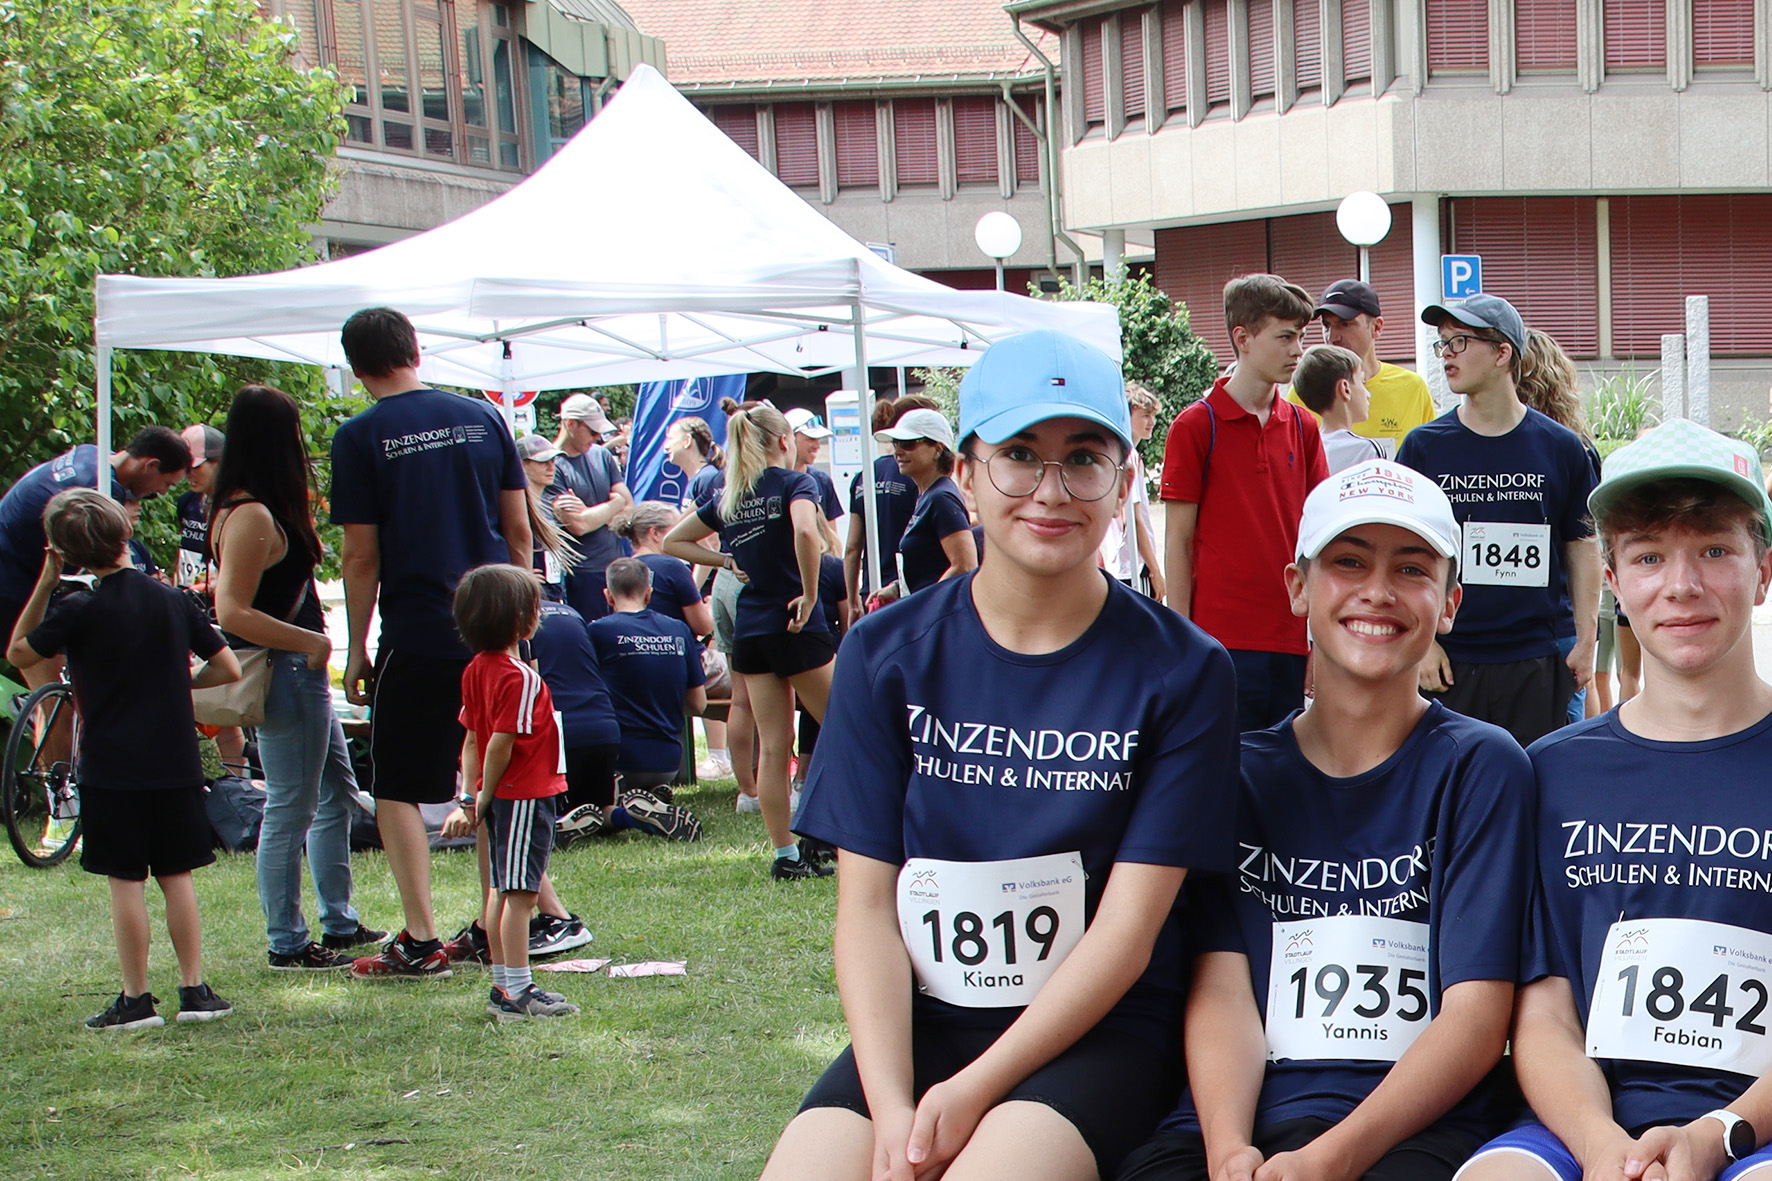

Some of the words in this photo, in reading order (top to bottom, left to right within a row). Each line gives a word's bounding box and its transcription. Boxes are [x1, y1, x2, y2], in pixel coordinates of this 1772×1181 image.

[1451, 260, 1472, 294] P
[382, 428, 451, 452] ZINZENDORF
[386, 447, 416, 460] SCHULEN
[423, 439, 454, 451] INTERNAT
[1438, 474, 1545, 490] ZINZENDORF
[1339, 488, 1368, 498] NEW
[1379, 487, 1414, 501] YORK
[1487, 493, 1494, 502] &
[1497, 491, 1543, 502] INTERNAT
[1472, 543, 1541, 569] 1848
[1495, 569, 1517, 579] Fynn
[617, 635, 673, 645] ZINZENDORF
[635, 643, 676, 652] SCHULEN
[906, 704, 1140, 762] ZINZENDORF
[1000, 767, 1018, 787] &
[1026, 766, 1133, 791] INTERNAT
[1018, 878, 1060, 890] Volksbank
[1062, 876, 1072, 884] eG
[1565, 863, 1657, 888] SCHULEN
[1663, 865, 1681, 885] &
[1240, 875, 1329, 917] SCHULEN
[1336, 902, 1353, 917] &
[923, 905, 1059, 966] 1819
[1388, 940, 1426, 953] Volksbank
[1729, 948, 1767, 963] Volksbank
[963, 971, 1024, 988] Kiana
[1290, 963, 1428, 1022] 1935
[1617, 964, 1768, 1036] 1842
[1322, 1023, 1388, 1040] Yannis
[1653, 1026, 1723, 1050] Fabian
